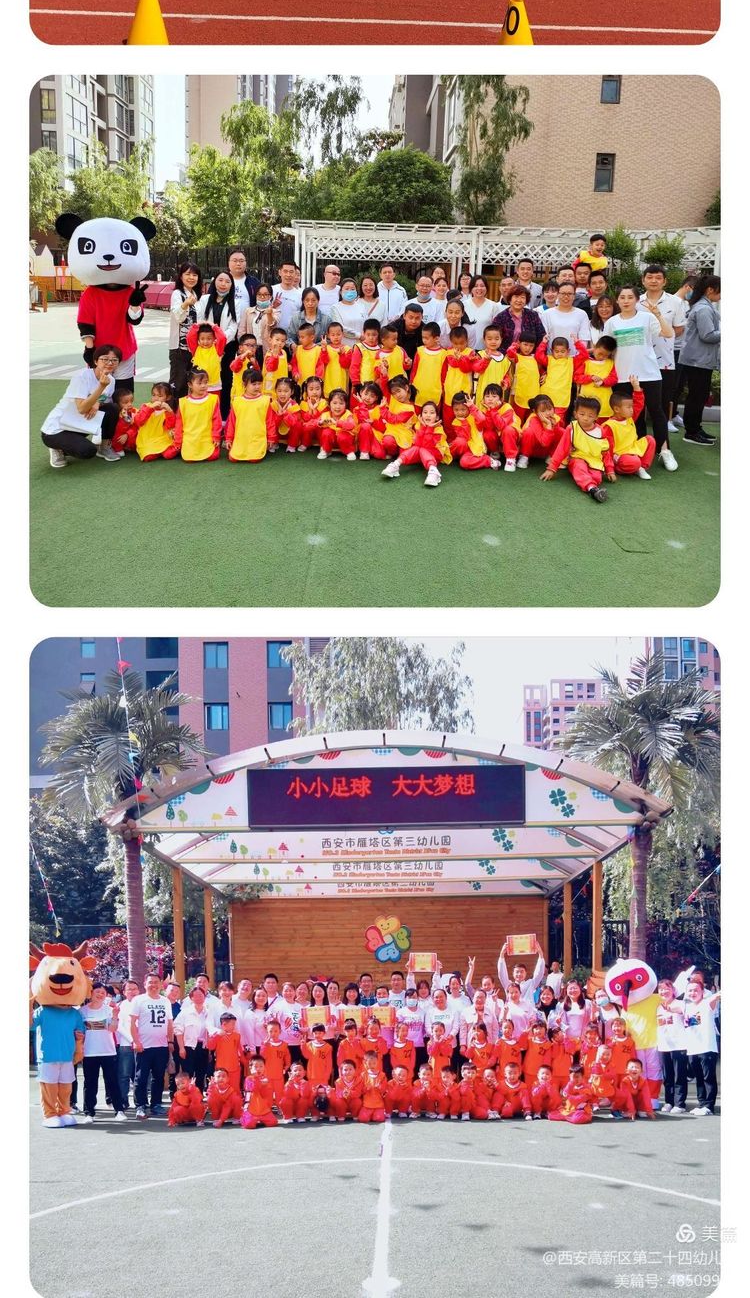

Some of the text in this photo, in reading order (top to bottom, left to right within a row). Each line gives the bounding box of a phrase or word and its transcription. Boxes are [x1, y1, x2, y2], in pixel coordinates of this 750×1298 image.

[287, 773, 476, 799] 小小足球 大大梦想
[322, 835, 451, 849] 西安市雁塔区第三幼儿园
[150, 1009, 166, 1023] 12
